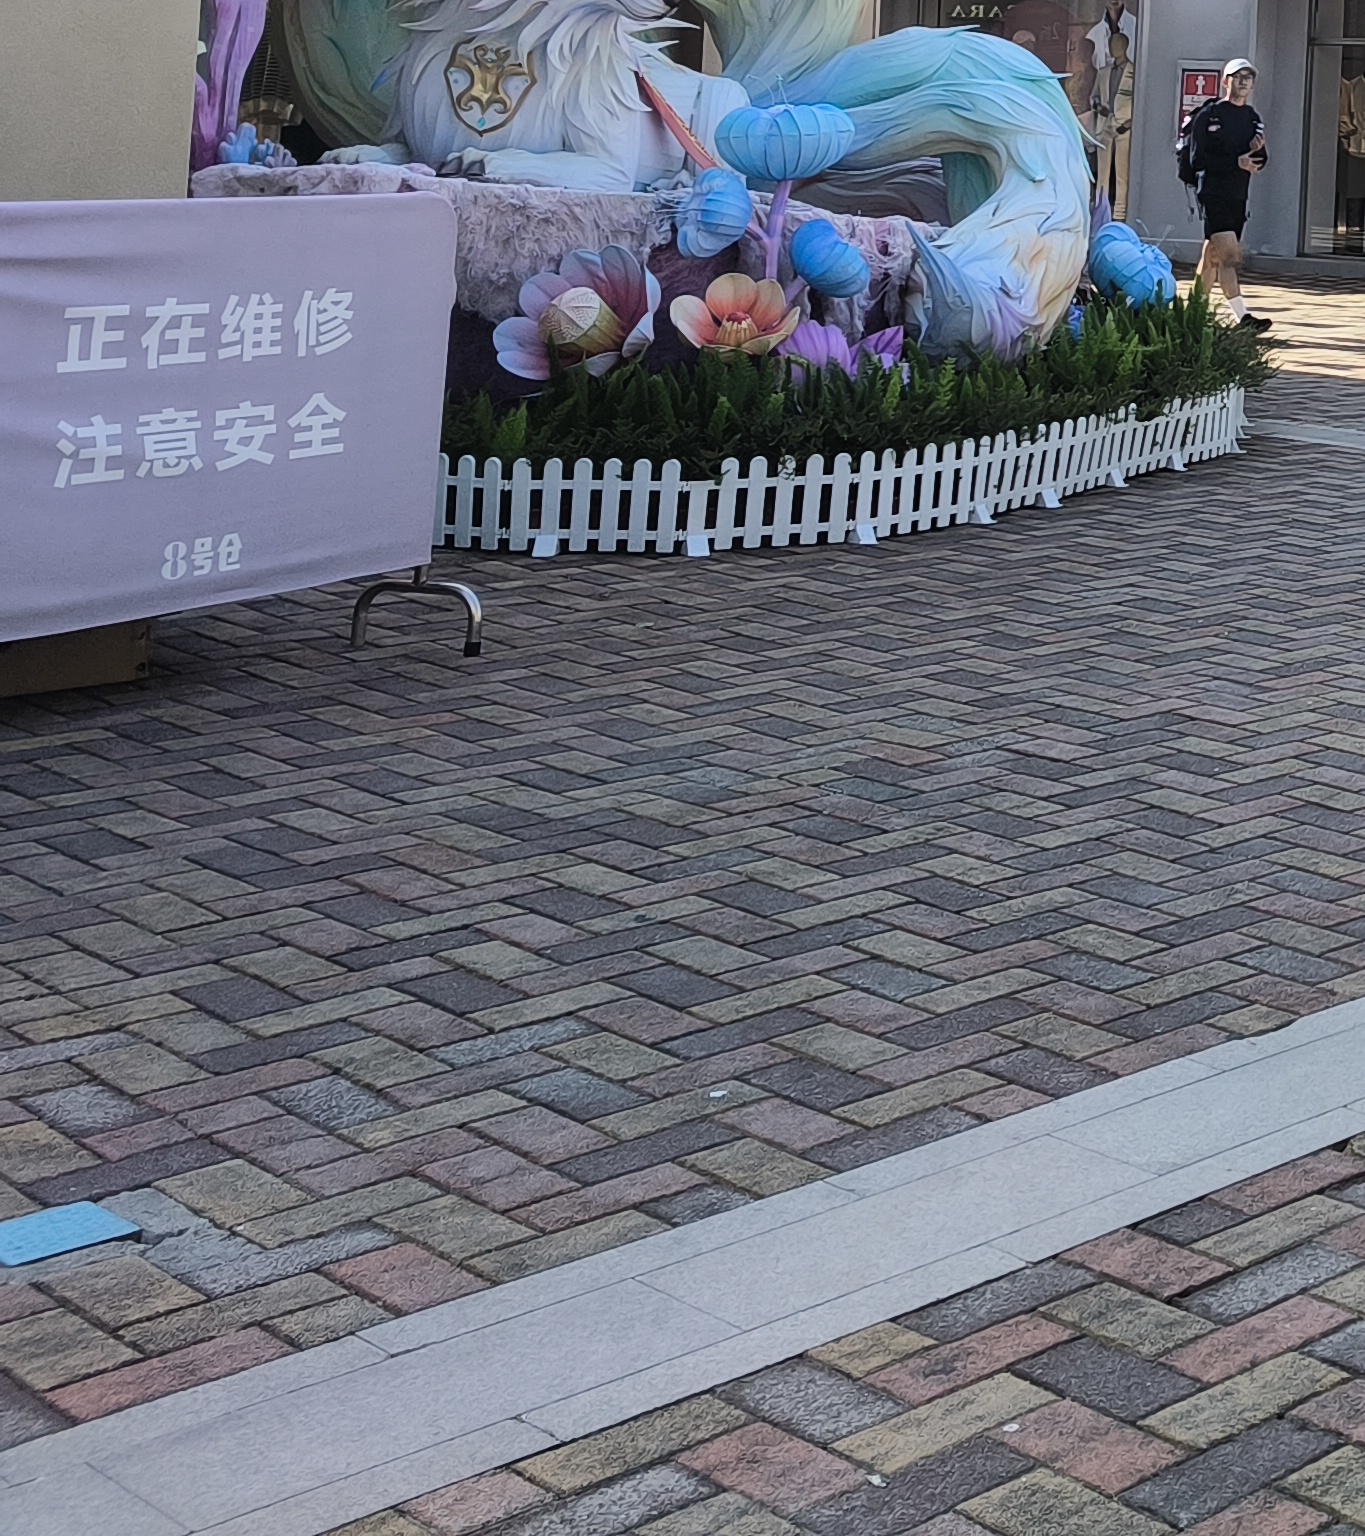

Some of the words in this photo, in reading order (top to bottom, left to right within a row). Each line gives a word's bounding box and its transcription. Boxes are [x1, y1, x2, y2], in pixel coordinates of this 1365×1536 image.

[55, 286, 356, 375] 正在维修
[52, 391, 349, 489] 注意安全
[160, 532, 243, 581] 8号仓
